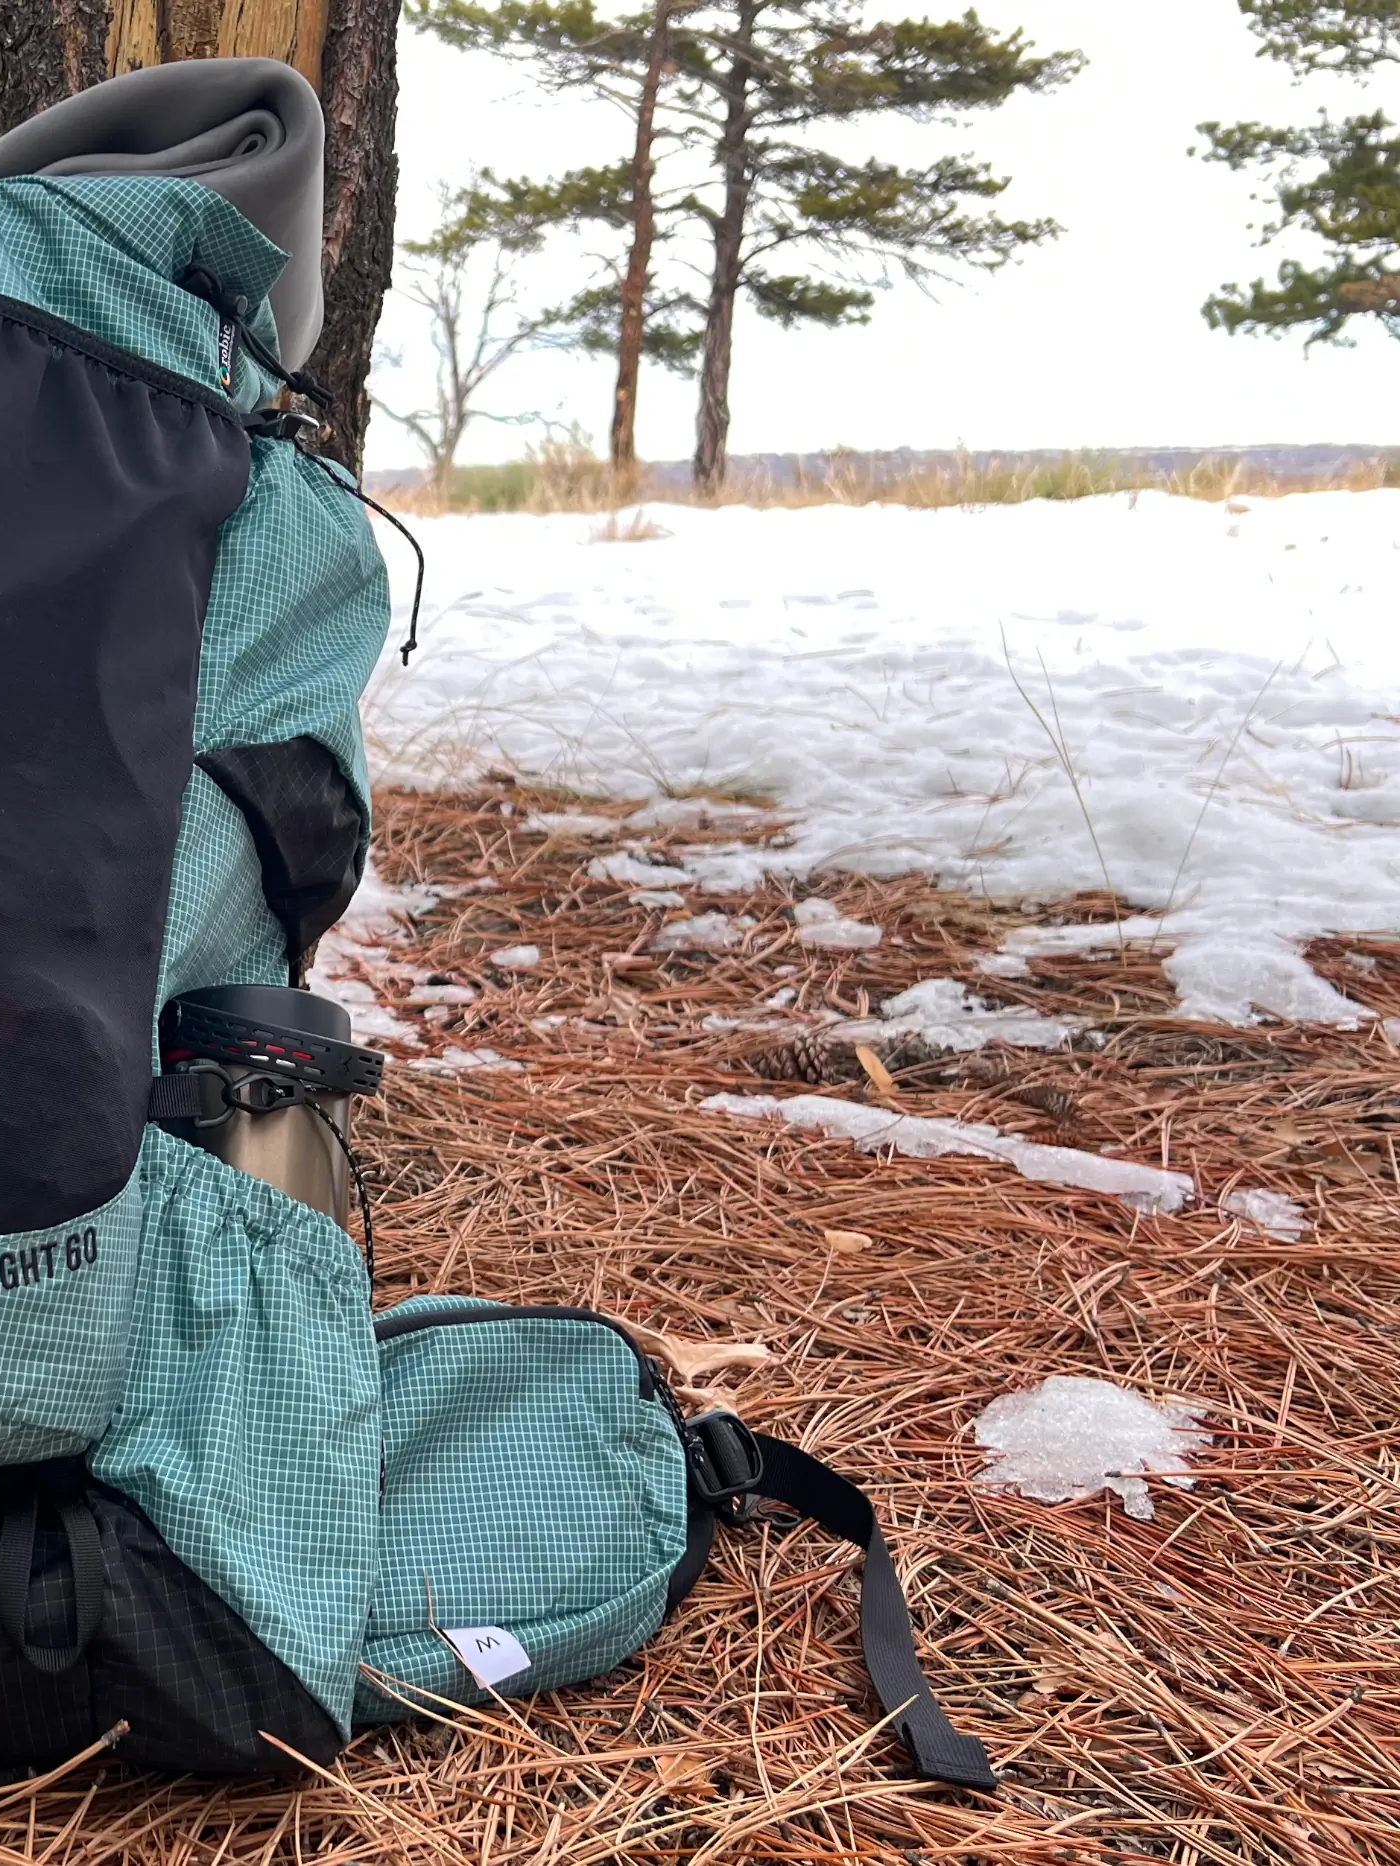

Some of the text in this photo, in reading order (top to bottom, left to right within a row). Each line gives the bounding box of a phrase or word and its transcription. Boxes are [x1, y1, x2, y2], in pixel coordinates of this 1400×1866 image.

[219, 324, 232, 367] robic
[67, 1226, 98, 1271] 60
[475, 1636, 500, 1653] M
